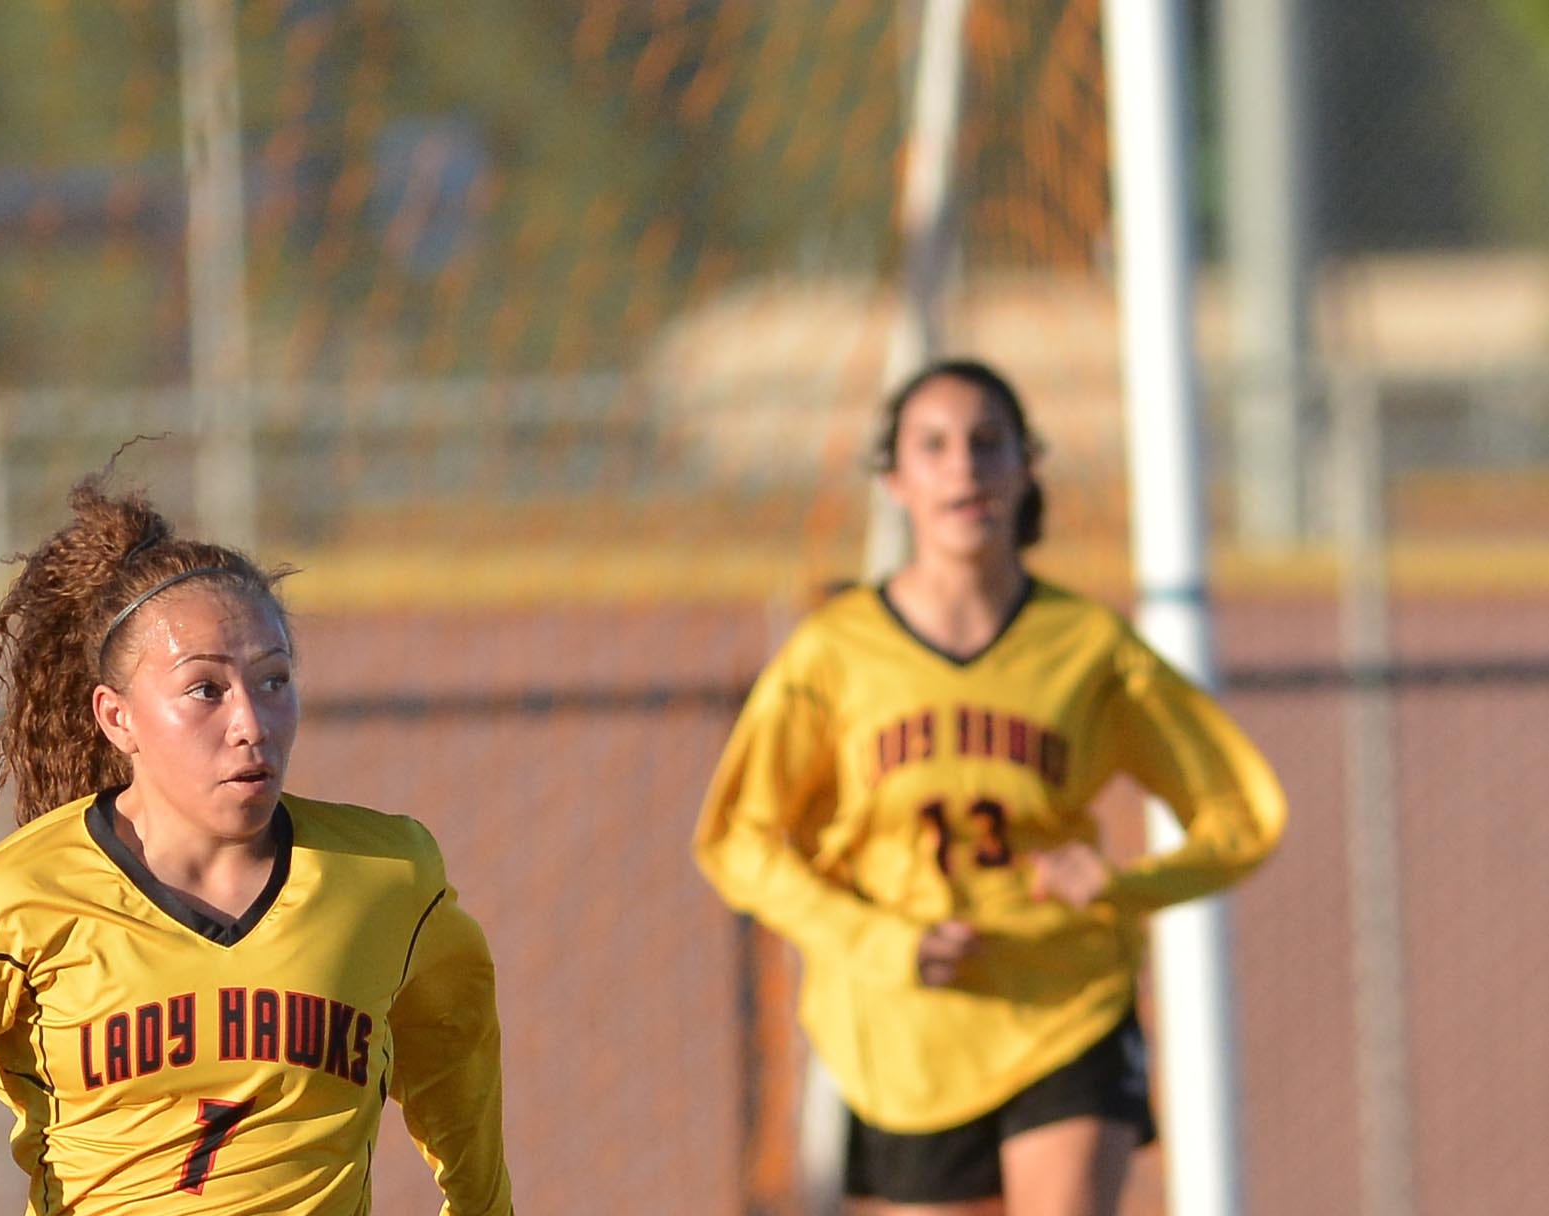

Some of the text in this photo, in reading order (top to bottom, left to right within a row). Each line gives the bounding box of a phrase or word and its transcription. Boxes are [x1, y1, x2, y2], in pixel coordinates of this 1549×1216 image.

[920, 796, 1013, 877] 13
[79, 986, 373, 1091] LADY HAWKS
[174, 1097, 257, 1196] 7
